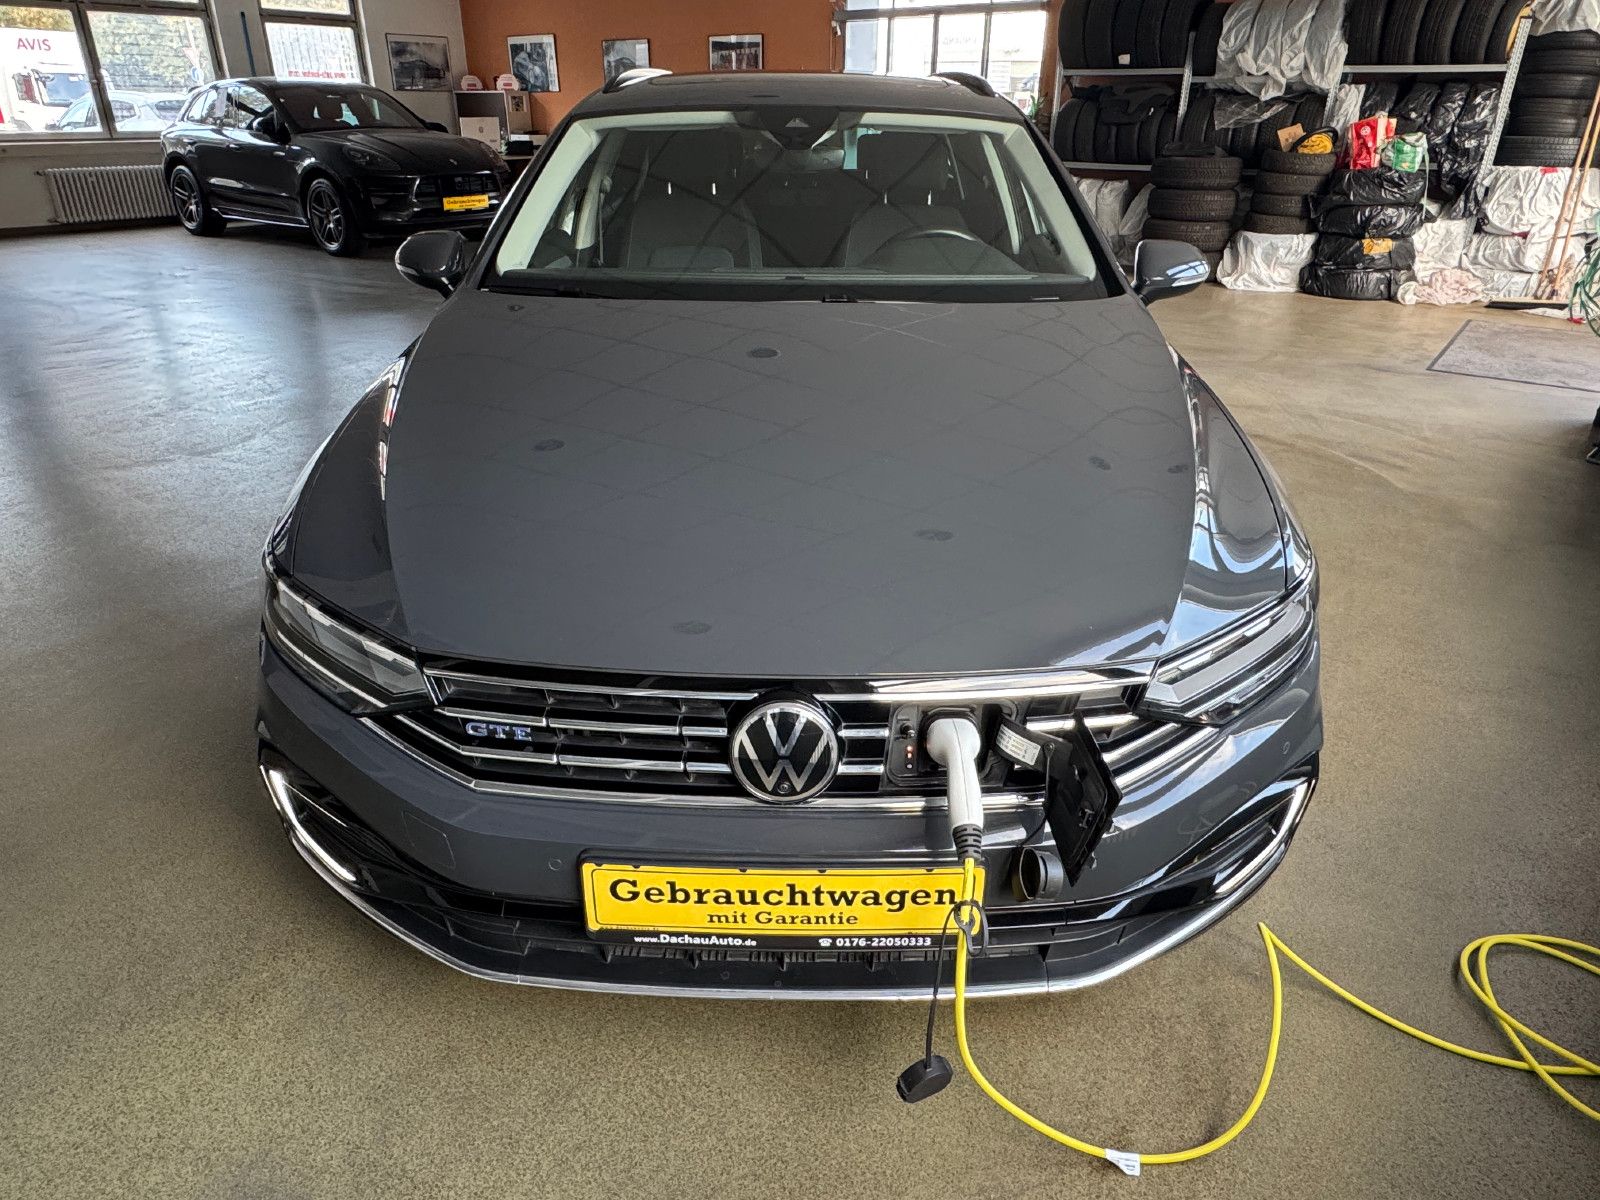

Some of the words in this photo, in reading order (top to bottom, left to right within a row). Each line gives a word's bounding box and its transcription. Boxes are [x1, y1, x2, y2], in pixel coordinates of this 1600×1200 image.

[17, 38, 52, 52] AVIS
[465, 722, 533, 742] GTE
[609, 878, 957, 912] Gebrauchtwagen
[707, 912, 747, 925] mit
[755, 911, 858, 925] Garantie
[633, 933, 757, 946] www.DachauAuto.de
[835, 937, 931, 947] 0176-22050333
